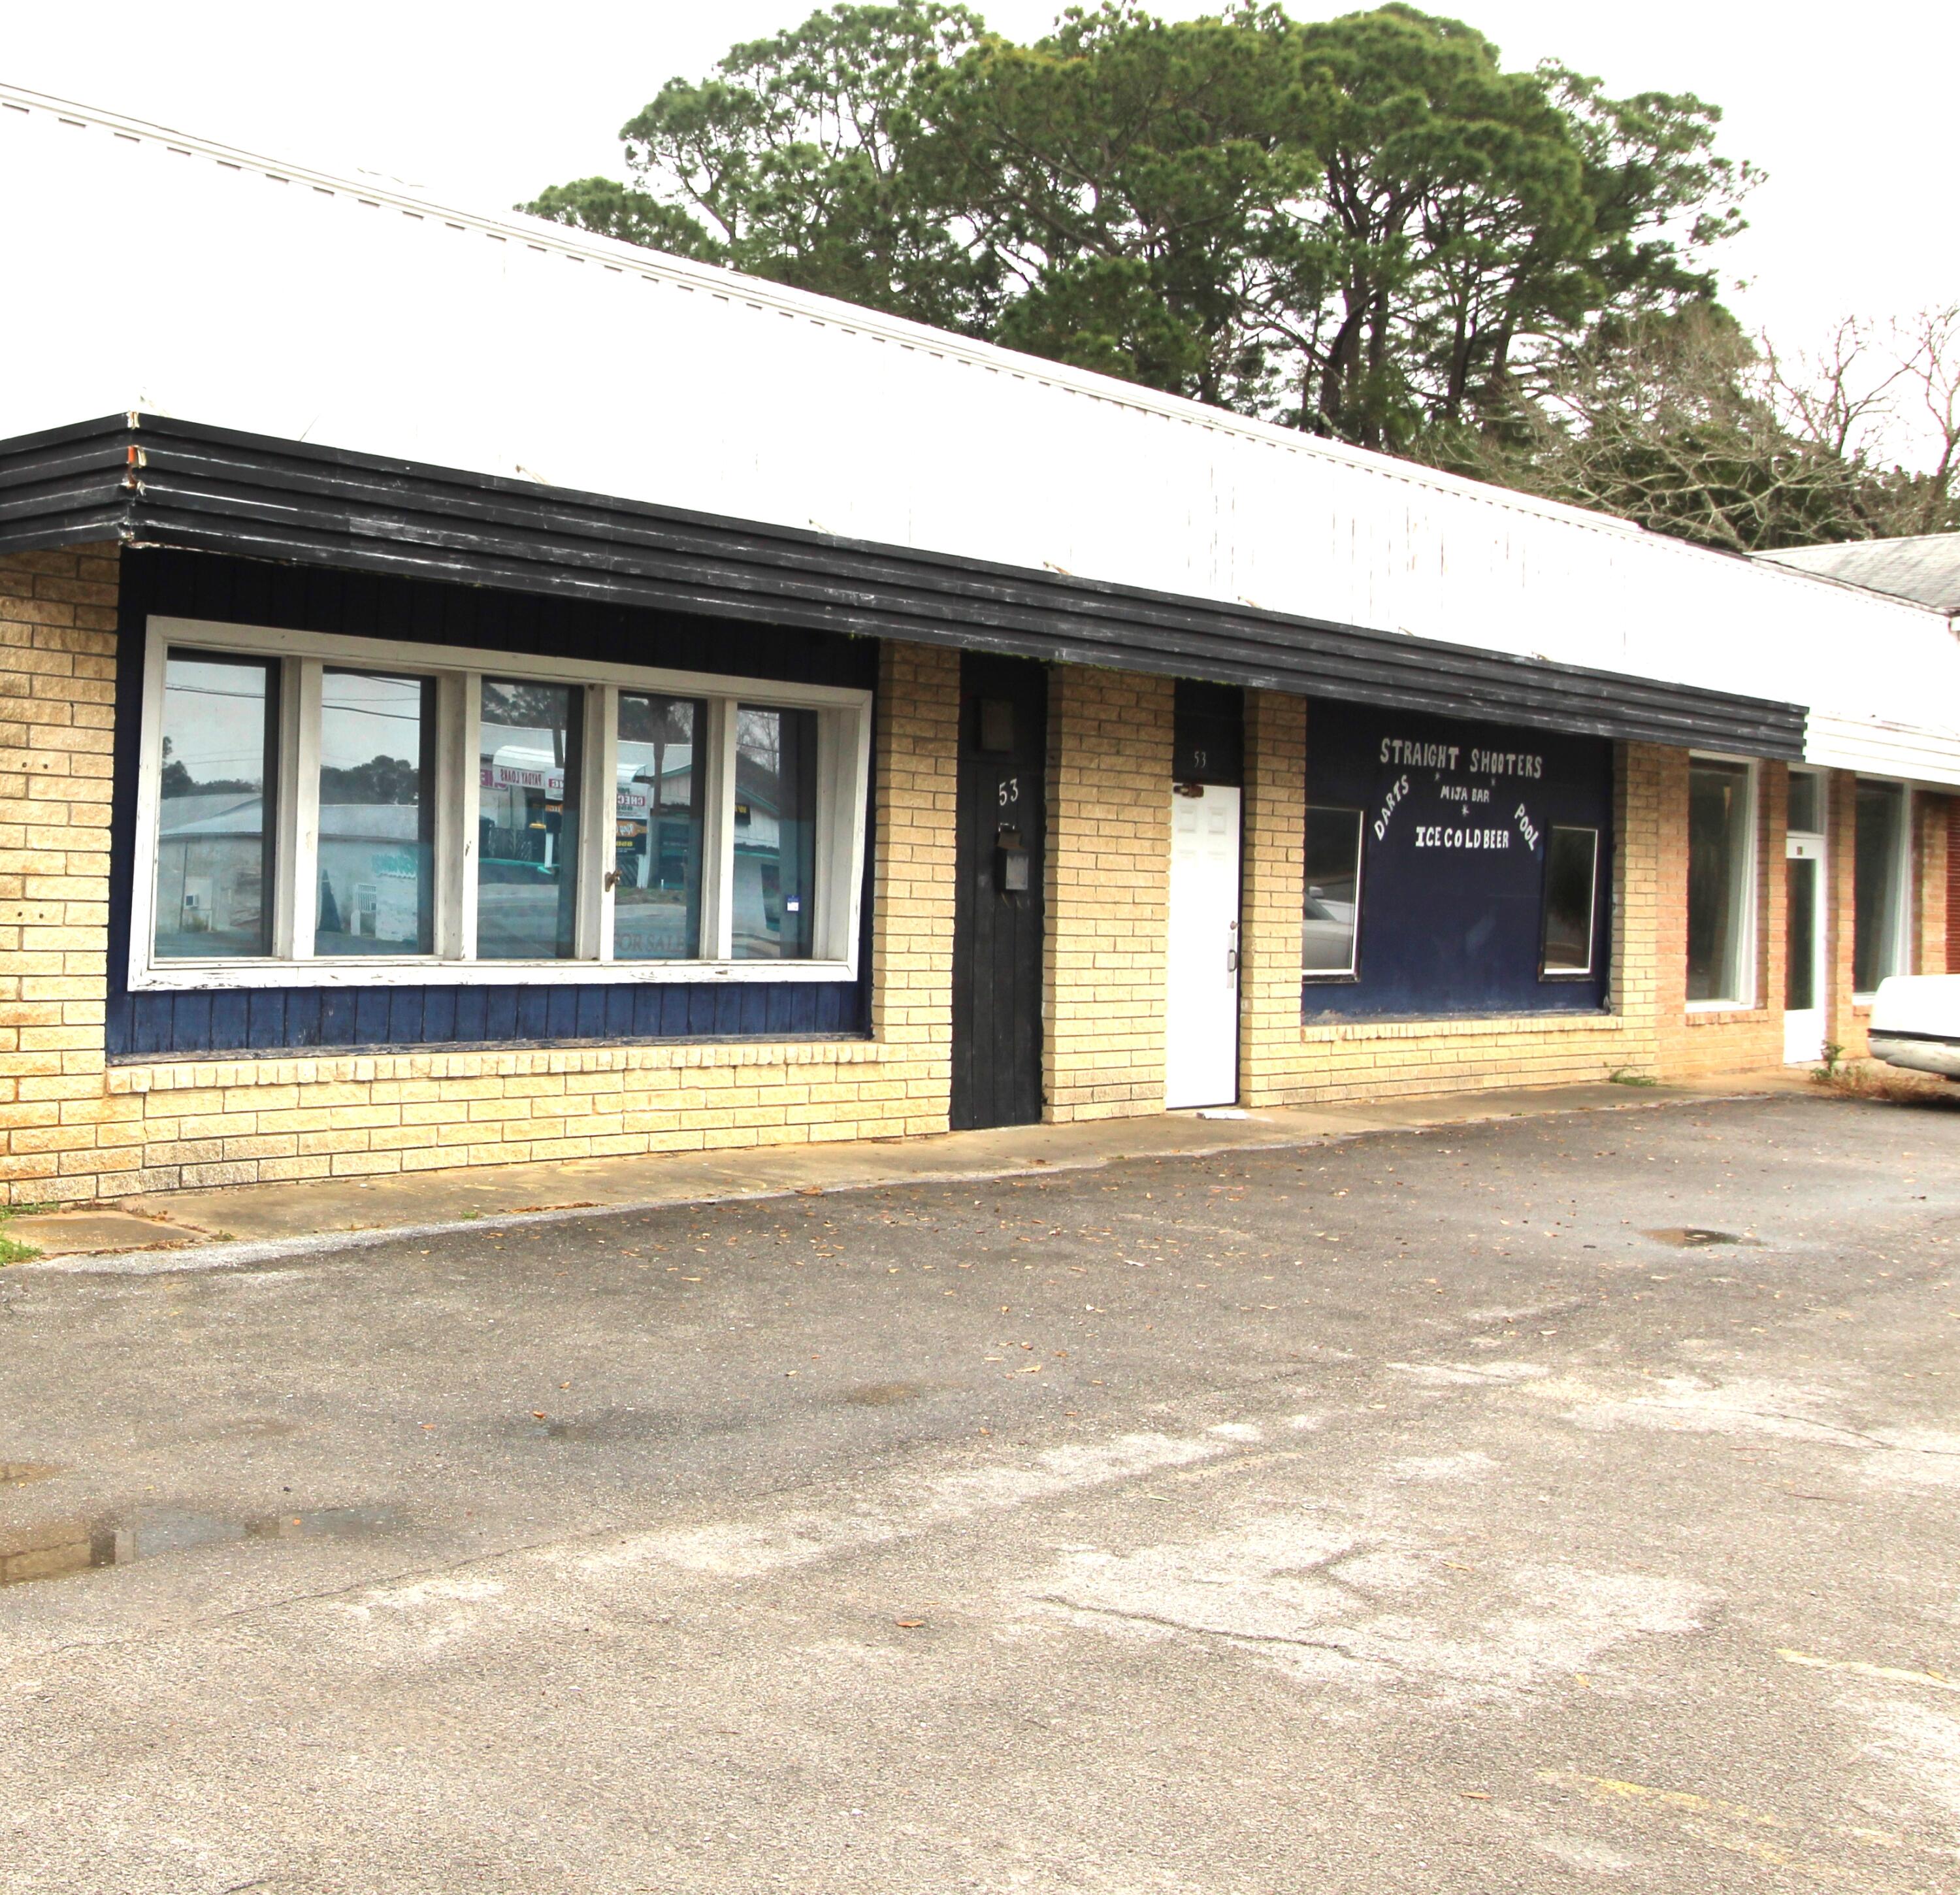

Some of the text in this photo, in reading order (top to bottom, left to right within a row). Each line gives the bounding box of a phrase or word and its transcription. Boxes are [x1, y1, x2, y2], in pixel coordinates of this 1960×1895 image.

[1194, 751, 1207, 768] 53
[1379, 737, 1543, 779] STRAIGHT SHOOTERS
[998, 778, 1019, 806] 53
[1440, 785, 1490, 802] MIJA BAR
[1373, 774, 1409, 841] DARTS
[1483, 829, 1509, 849] BEER
[1514, 802, 1539, 851] POOL
